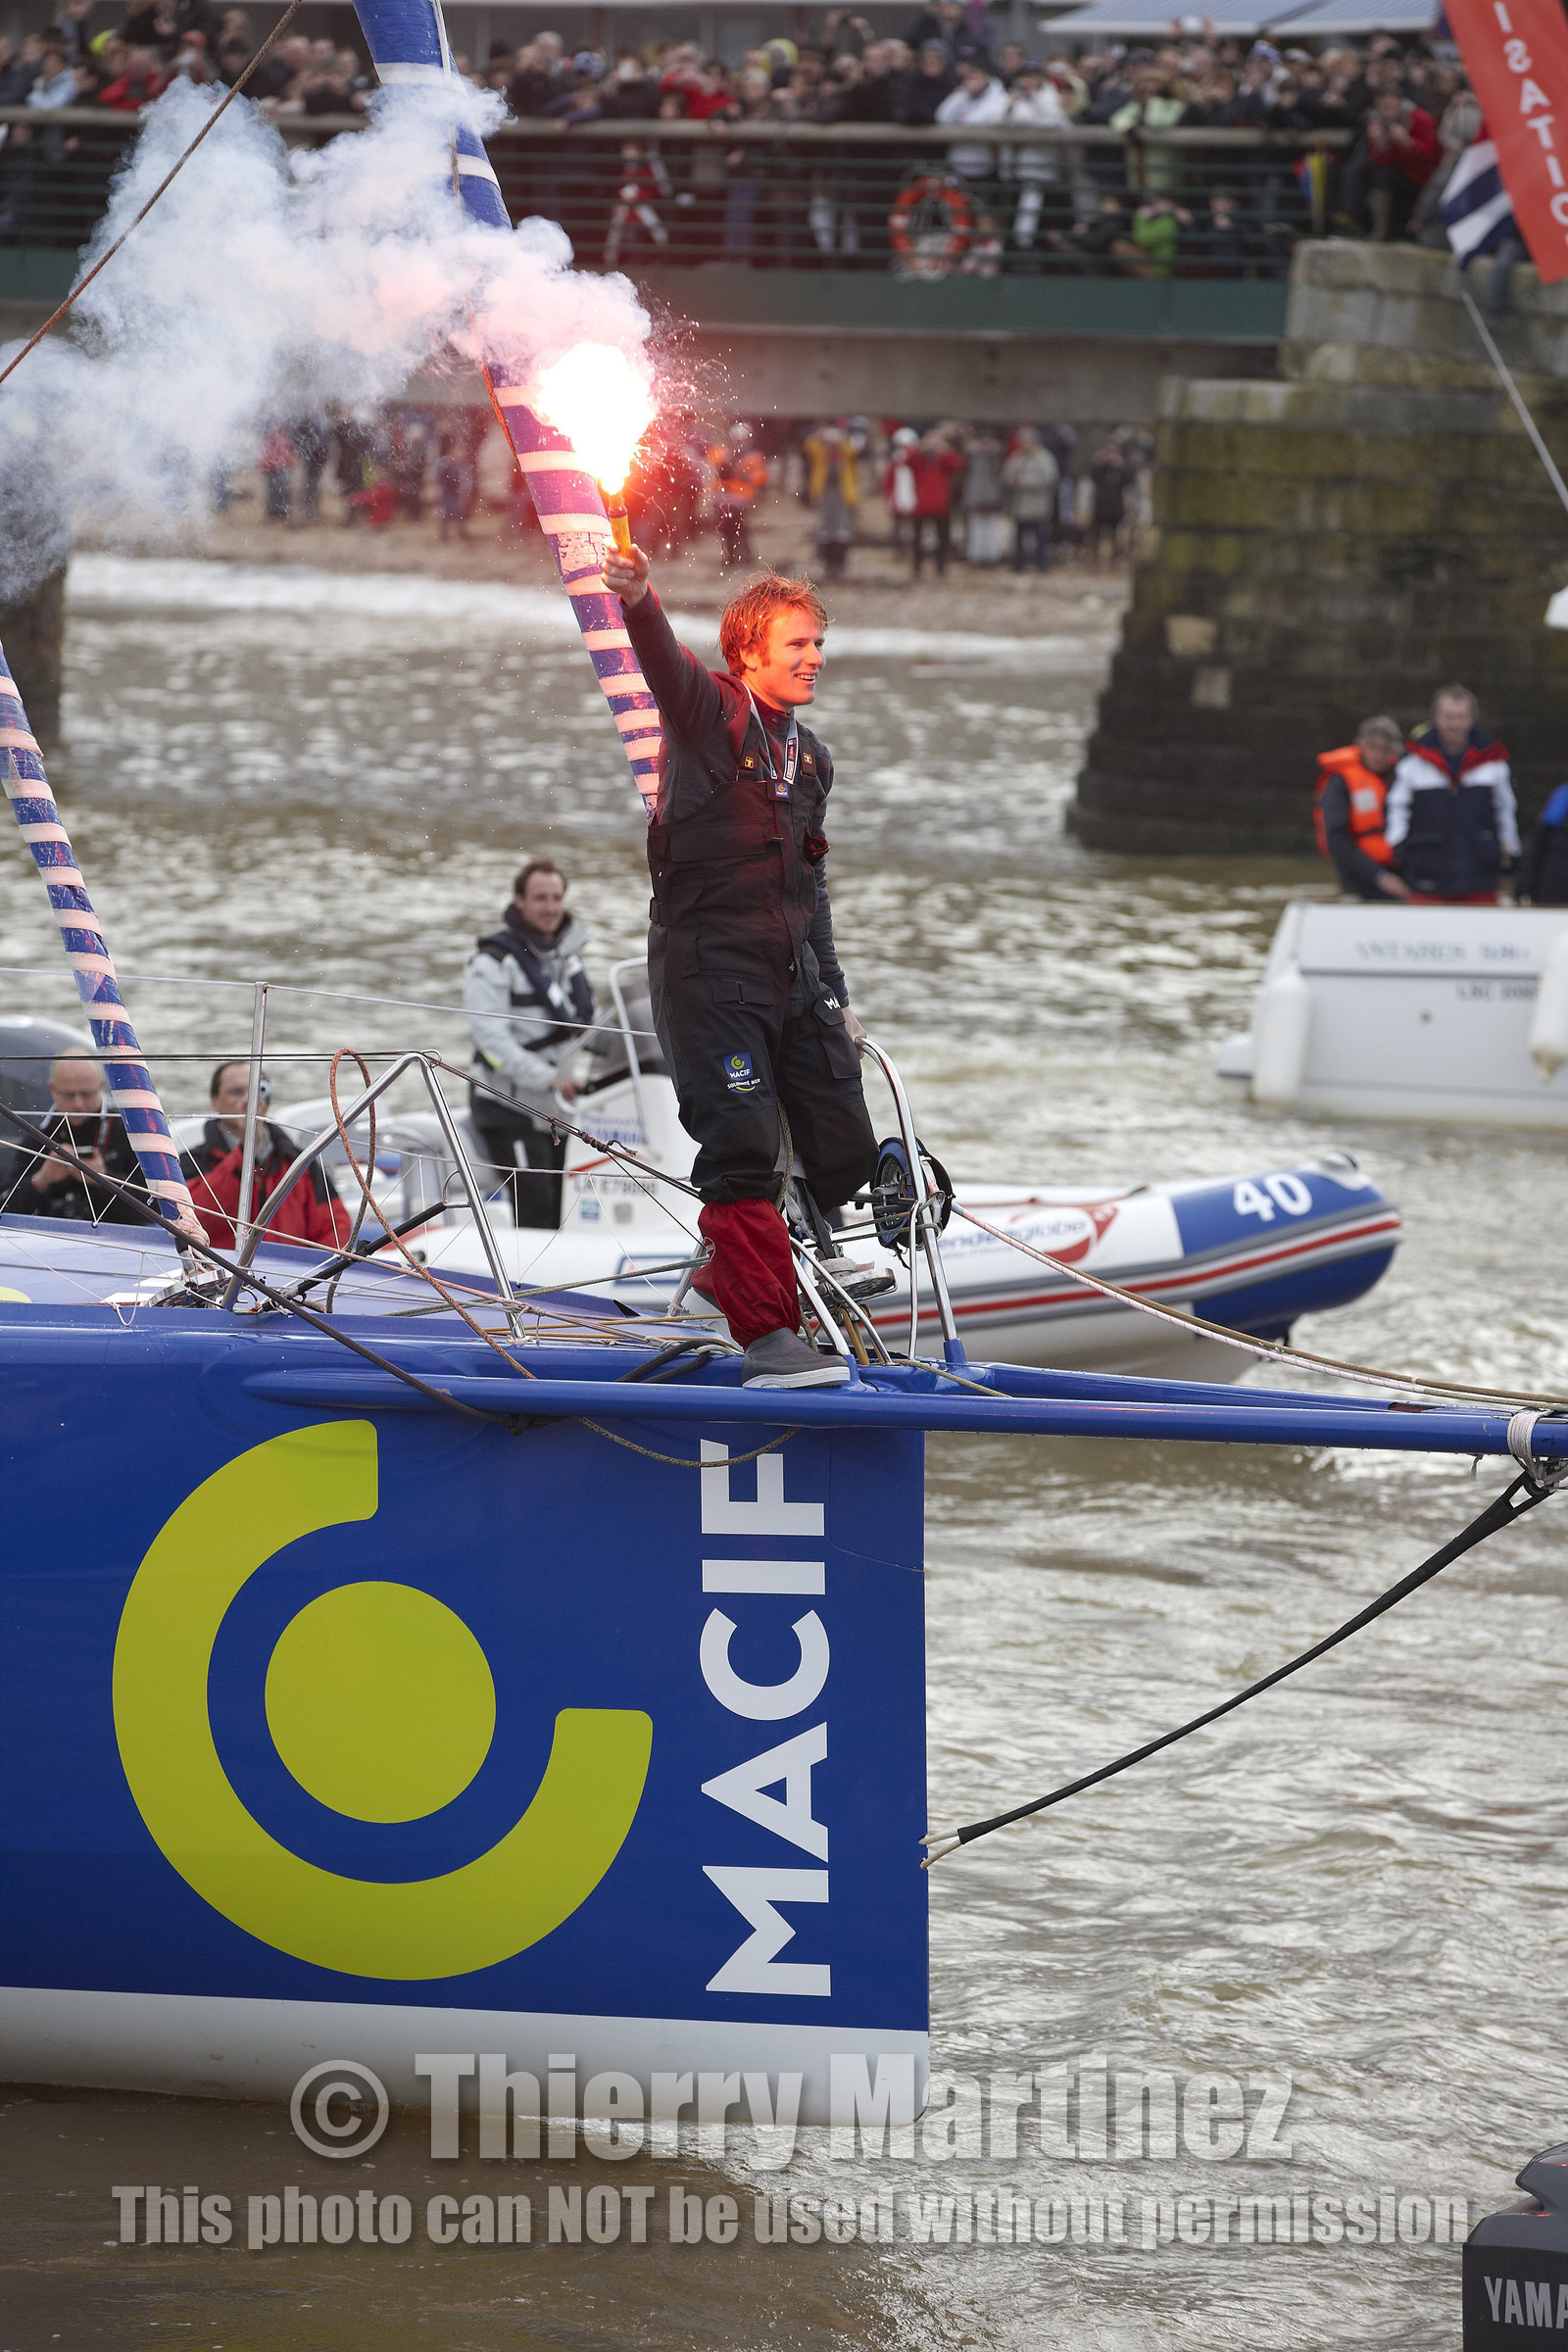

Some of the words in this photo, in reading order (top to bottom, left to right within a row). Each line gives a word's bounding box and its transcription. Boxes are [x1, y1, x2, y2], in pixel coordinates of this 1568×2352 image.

[729, 1068, 751, 1078] MACIF
[1234, 1173, 1312, 1222] 40
[700, 1439, 831, 1996] MACIF
